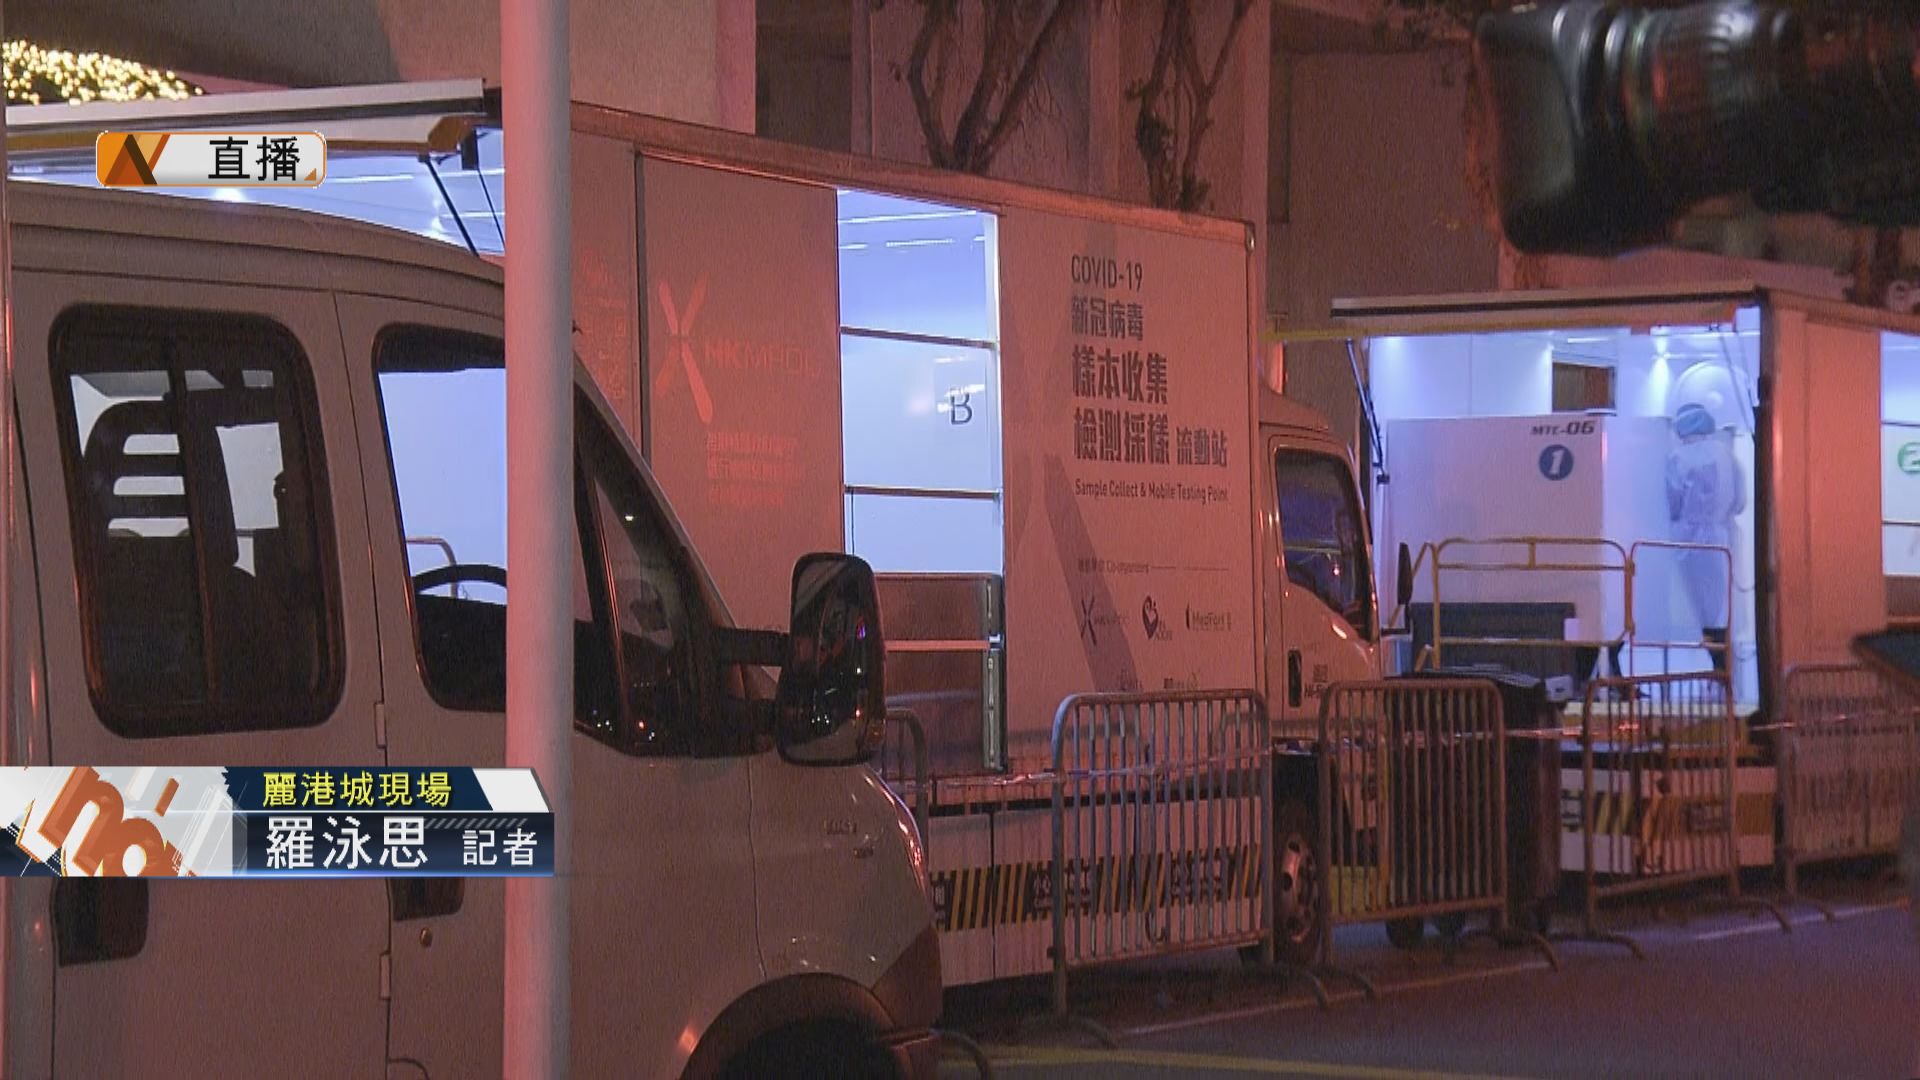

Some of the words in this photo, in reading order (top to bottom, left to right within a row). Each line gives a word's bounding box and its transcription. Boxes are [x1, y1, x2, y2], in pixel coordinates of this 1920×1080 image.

[1071, 255, 1143, 292] COVID-19
[1071, 296, 1144, 341] 新冠病毒
[1072, 344, 1168, 405] 樣本收集
[950, 387, 973, 425] B
[1073, 407, 1170, 465] 檢測採樣
[1176, 427, 1228, 468] 流動站
[1075, 478, 1107, 499] Sample
[1109, 480, 1138, 497] Collect
[1140, 482, 1146, 497] &
[1149, 482, 1175, 499] Mobile
[1177, 483, 1206, 504] Testing
[1207, 486, 1228, 504] Point
